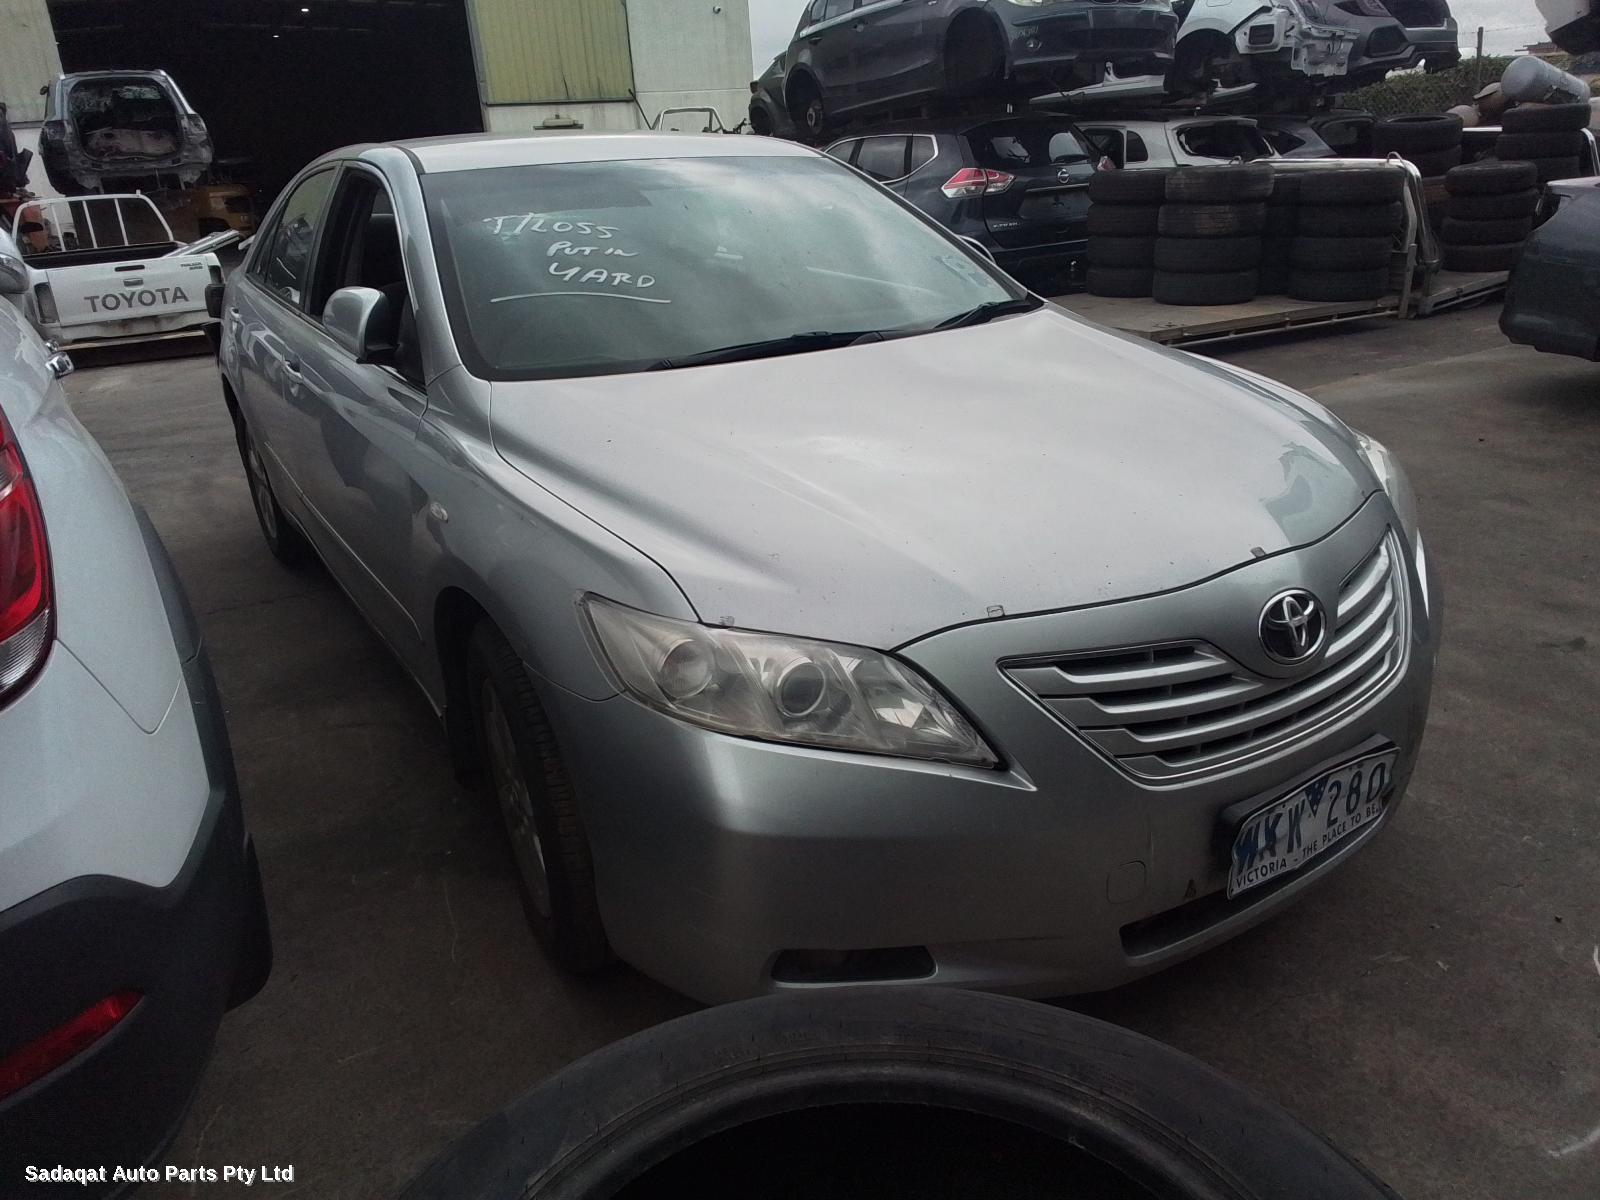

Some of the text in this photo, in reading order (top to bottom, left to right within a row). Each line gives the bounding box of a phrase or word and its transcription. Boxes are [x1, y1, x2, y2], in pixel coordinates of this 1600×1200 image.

[548, 262, 656, 288] YARD
[83, 286, 190, 313] TOYOTA
[1326, 761, 1387, 829] 280
[1235, 857, 1288, 889] VICTORIA
[1301, 839, 1319, 858] THE
[1322, 820, 1348, 846] PLACE
[1350, 811, 1363, 827] TO
